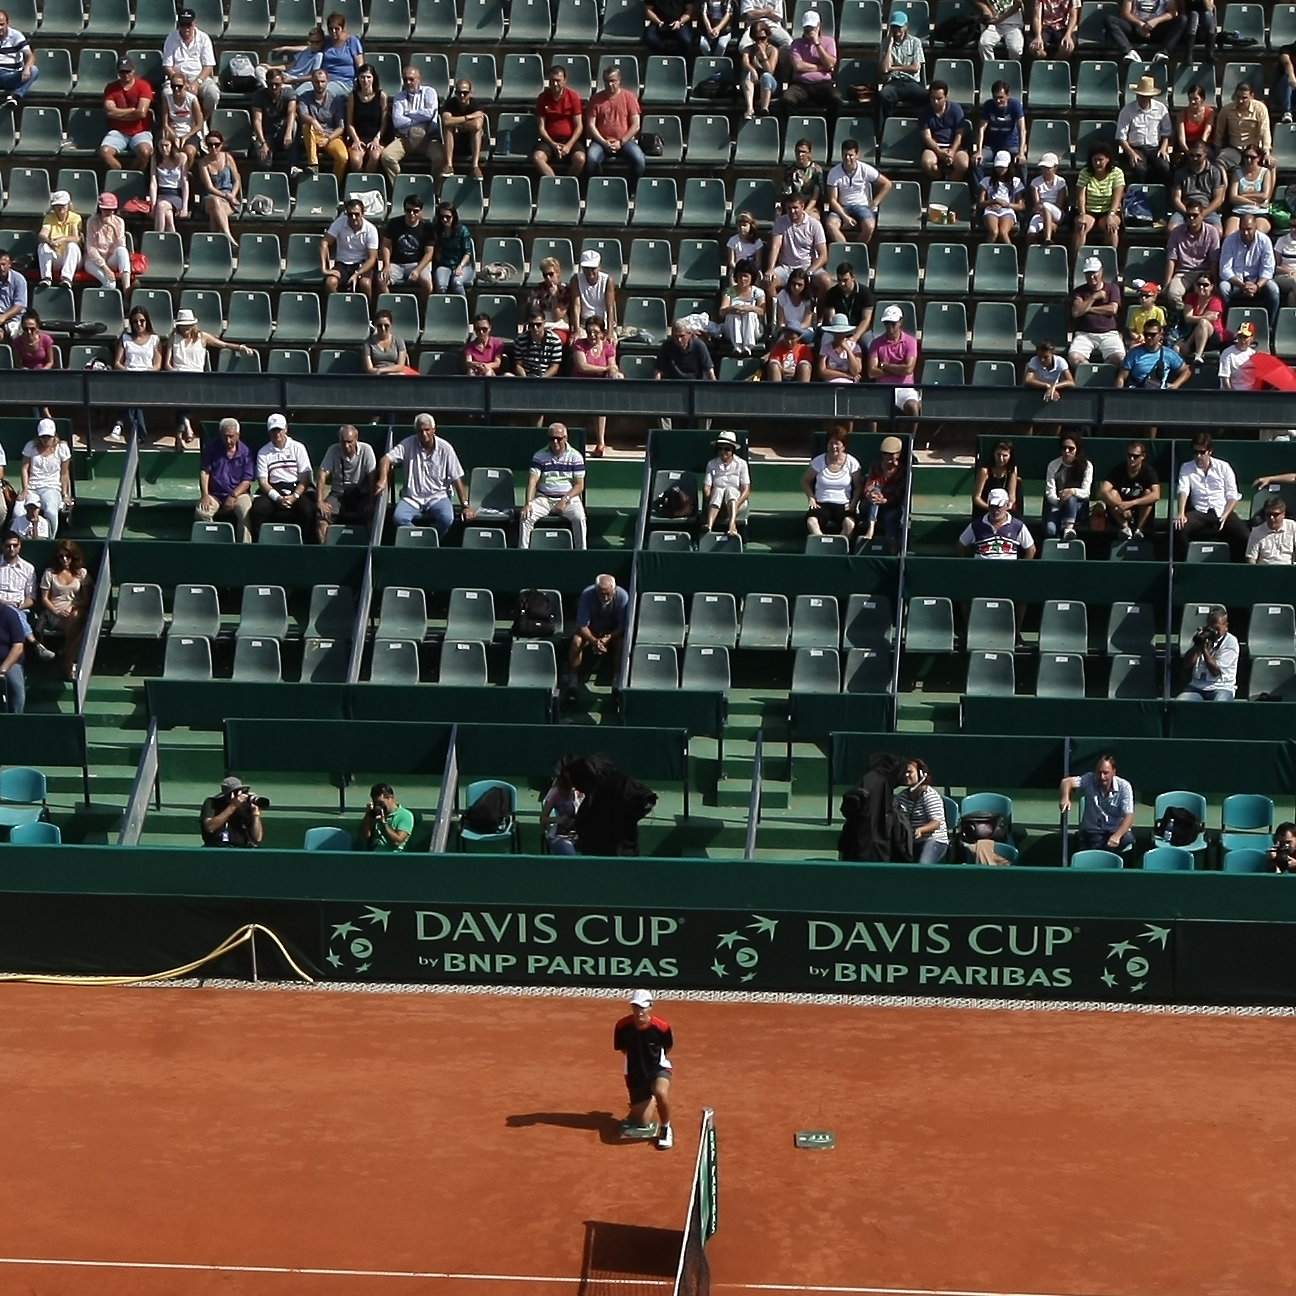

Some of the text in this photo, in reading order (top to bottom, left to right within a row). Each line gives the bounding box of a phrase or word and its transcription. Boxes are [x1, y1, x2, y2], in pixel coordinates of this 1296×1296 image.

[414, 910, 678, 947] DAVIS CUP
[807, 920, 1073, 956] DAVIS CUP
[419, 953, 679, 978] by BNP PARIBAS
[809, 963, 1073, 987] by BNP PARIBAS
